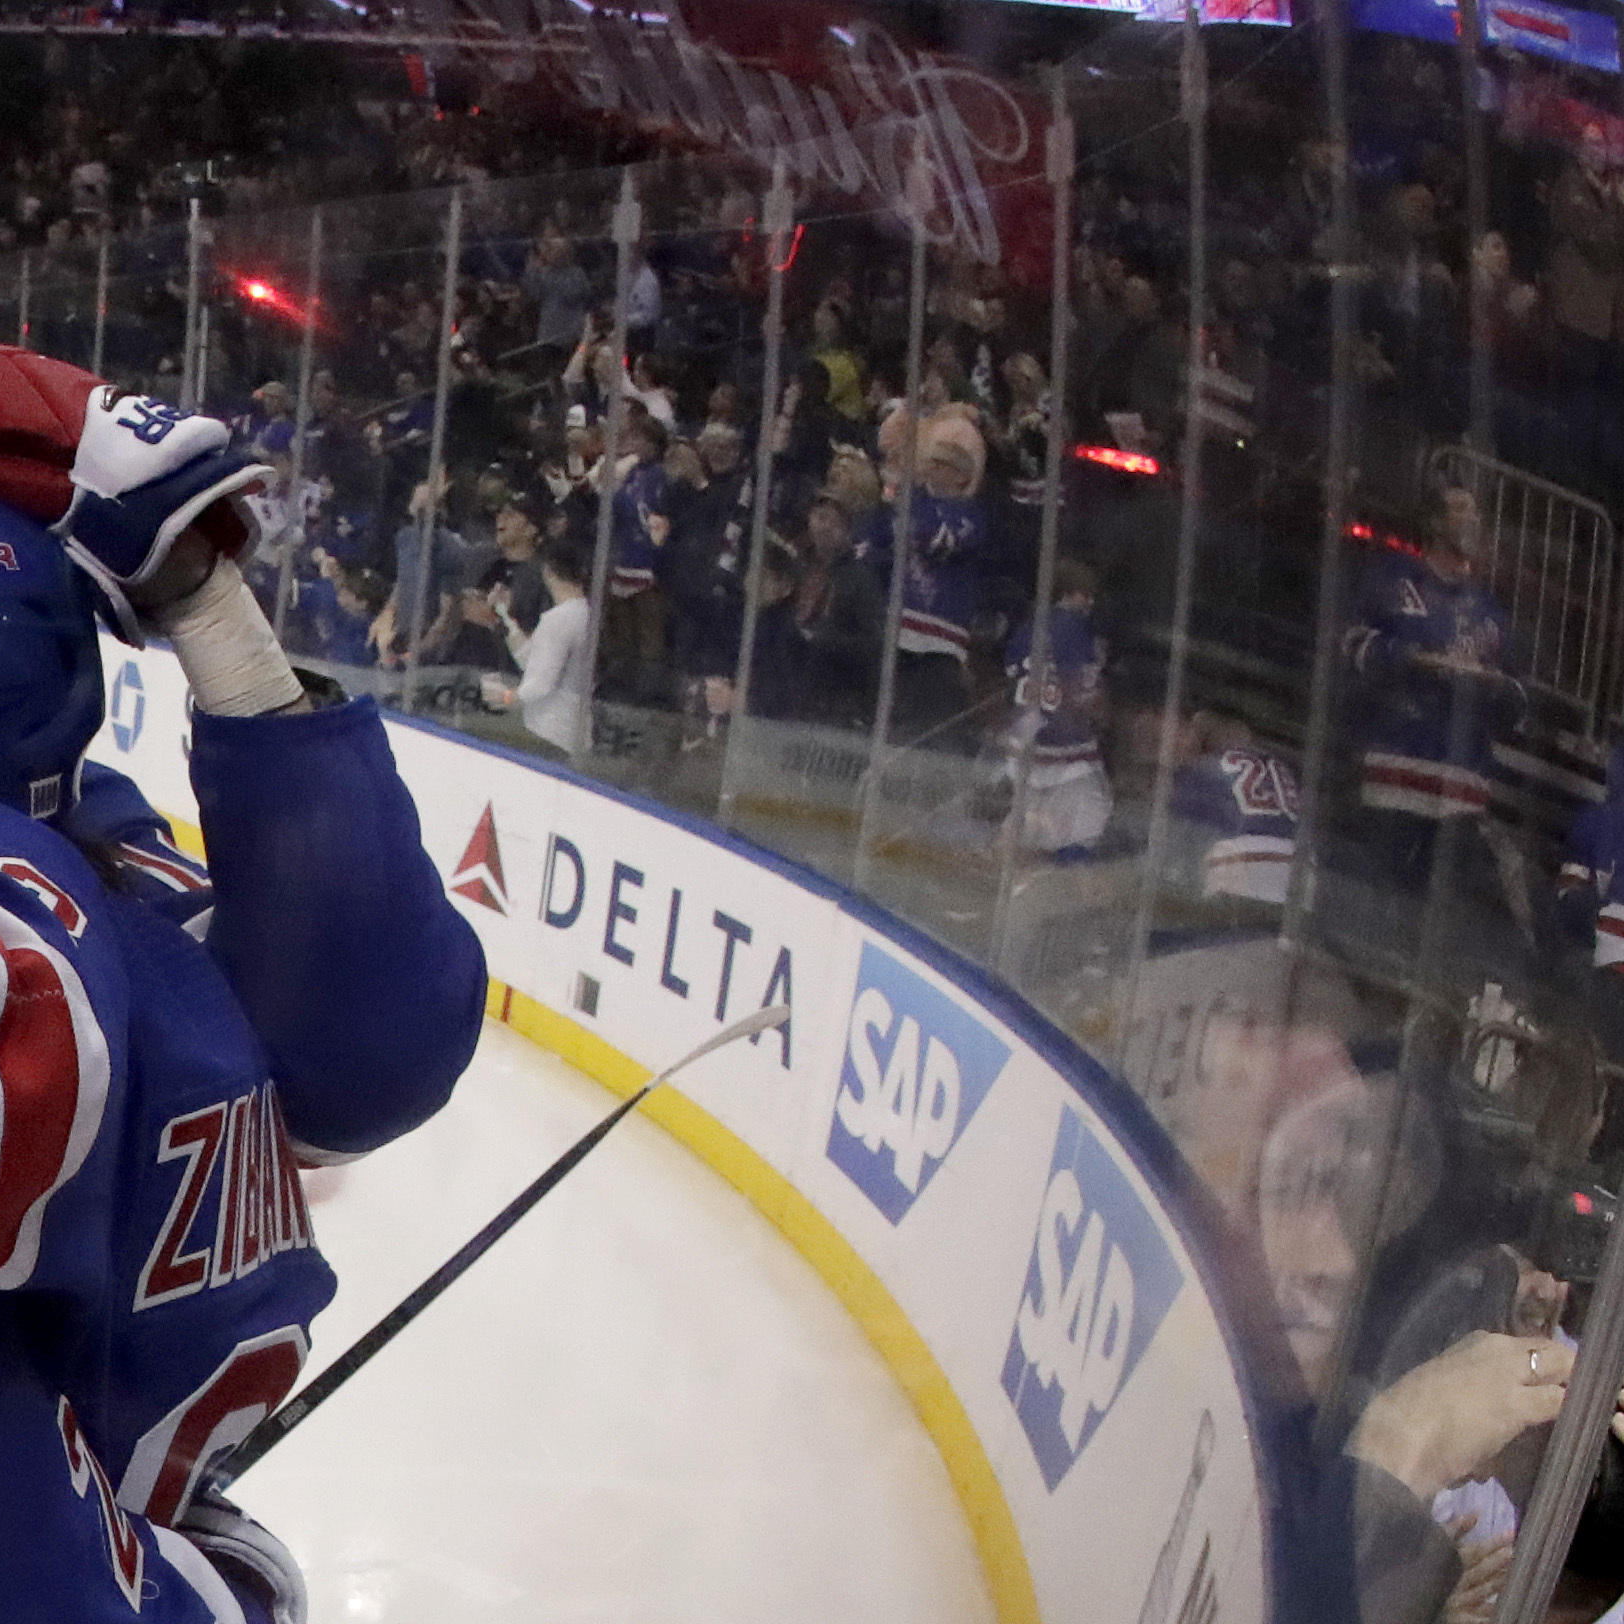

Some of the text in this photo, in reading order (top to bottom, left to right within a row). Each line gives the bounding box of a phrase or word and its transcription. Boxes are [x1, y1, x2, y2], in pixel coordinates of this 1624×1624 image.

[541, 831, 793, 1071] DELTA
[838, 988, 961, 1194] SAP
[1019, 1170, 1136, 1454] SAP
